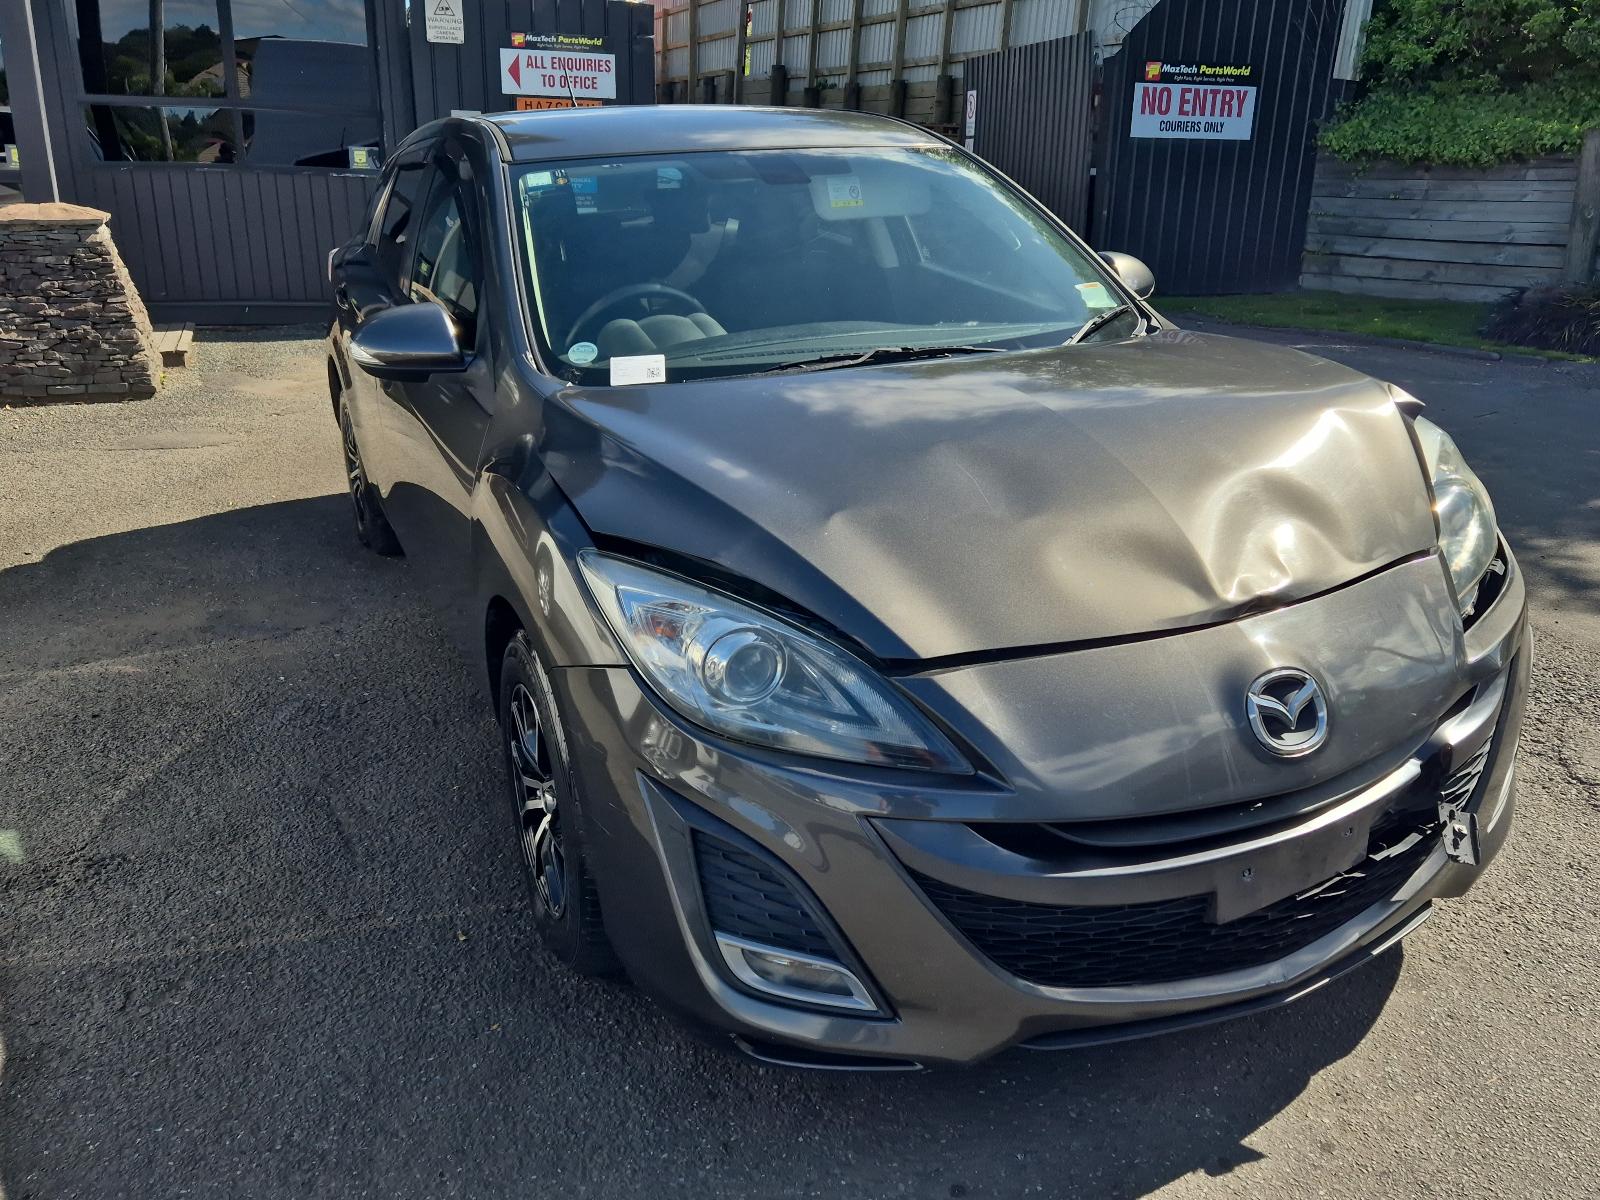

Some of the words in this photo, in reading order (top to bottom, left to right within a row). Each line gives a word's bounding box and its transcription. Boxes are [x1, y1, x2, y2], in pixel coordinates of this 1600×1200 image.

[525, 34, 556, 43] MazTech
[558, 36, 602, 46] PartsWorld
[526, 55, 547, 69] ALL
[551, 56, 611, 73] ENQUIRIES
[1161, 64, 1197, 74] MazTech
[1199, 65, 1251, 76] PartsWorld
[541, 74, 556, 88] TO
[1141, 86, 1172, 116] NO
[1178, 87, 1248, 118] ENTRY
[1160, 120, 1201, 133] COURIERS
[1204, 121, 1225, 133] ONLY
